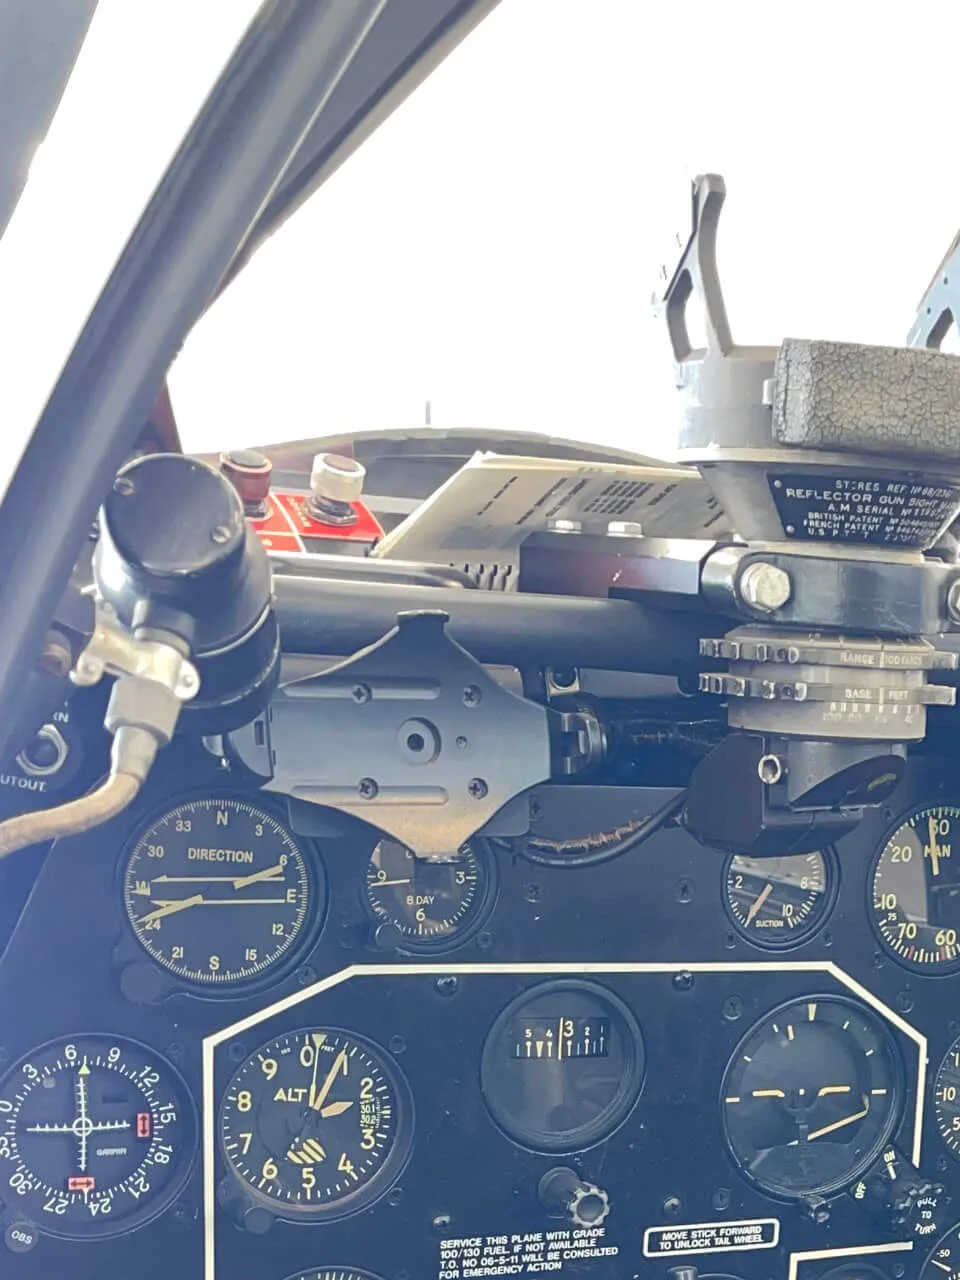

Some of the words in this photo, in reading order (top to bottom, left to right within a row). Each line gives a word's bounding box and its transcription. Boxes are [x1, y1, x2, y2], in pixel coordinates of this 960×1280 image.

[786, 488, 871, 502] REFLECTOR
[188, 847, 254, 864] DIRECTION
[756, 920, 783, 928] SUCTION
[274, 1088, 307, 1102] ALT
[440, 1238, 482, 1249] SERVICE
[486, 1236, 508, 1245] THIS
[511, 1233, 542, 1243] PLANE
[546, 1231, 569, 1241] WITH
[573, 1228, 605, 1238] GRADE
[662, 1230, 687, 1241] MOVE
[691, 1228, 716, 1238] STICK
[719, 1225, 762, 1236] FORWARD
[441, 1248, 480, 1259] 100/130
[513, 1245, 522, 1253] IF
[525, 1242, 545, 1252] NOT
[548, 1239, 596, 1250] AVAILABLE
[660, 1240, 671, 1250] TO
[674, 1238, 711, 1249] UNLOCK
[714, 1236, 731, 1246] TAIL
[733, 1234, 763, 1244] WHEEL
[440, 1261, 458, 1269] T.O.
[462, 1258, 477, 1267] NO
[481, 1256, 518, 1266] 06-5-11
[522, 1253, 544, 1262] WILL
[547, 1252, 560, 1260] BE
[563, 1247, 618, 1259] CONSULTED
[439, 1271, 459, 1280] FOR
[463, 1266, 524, 1278] EMERGENCY
[527, 1261, 562, 1272] ACTION
